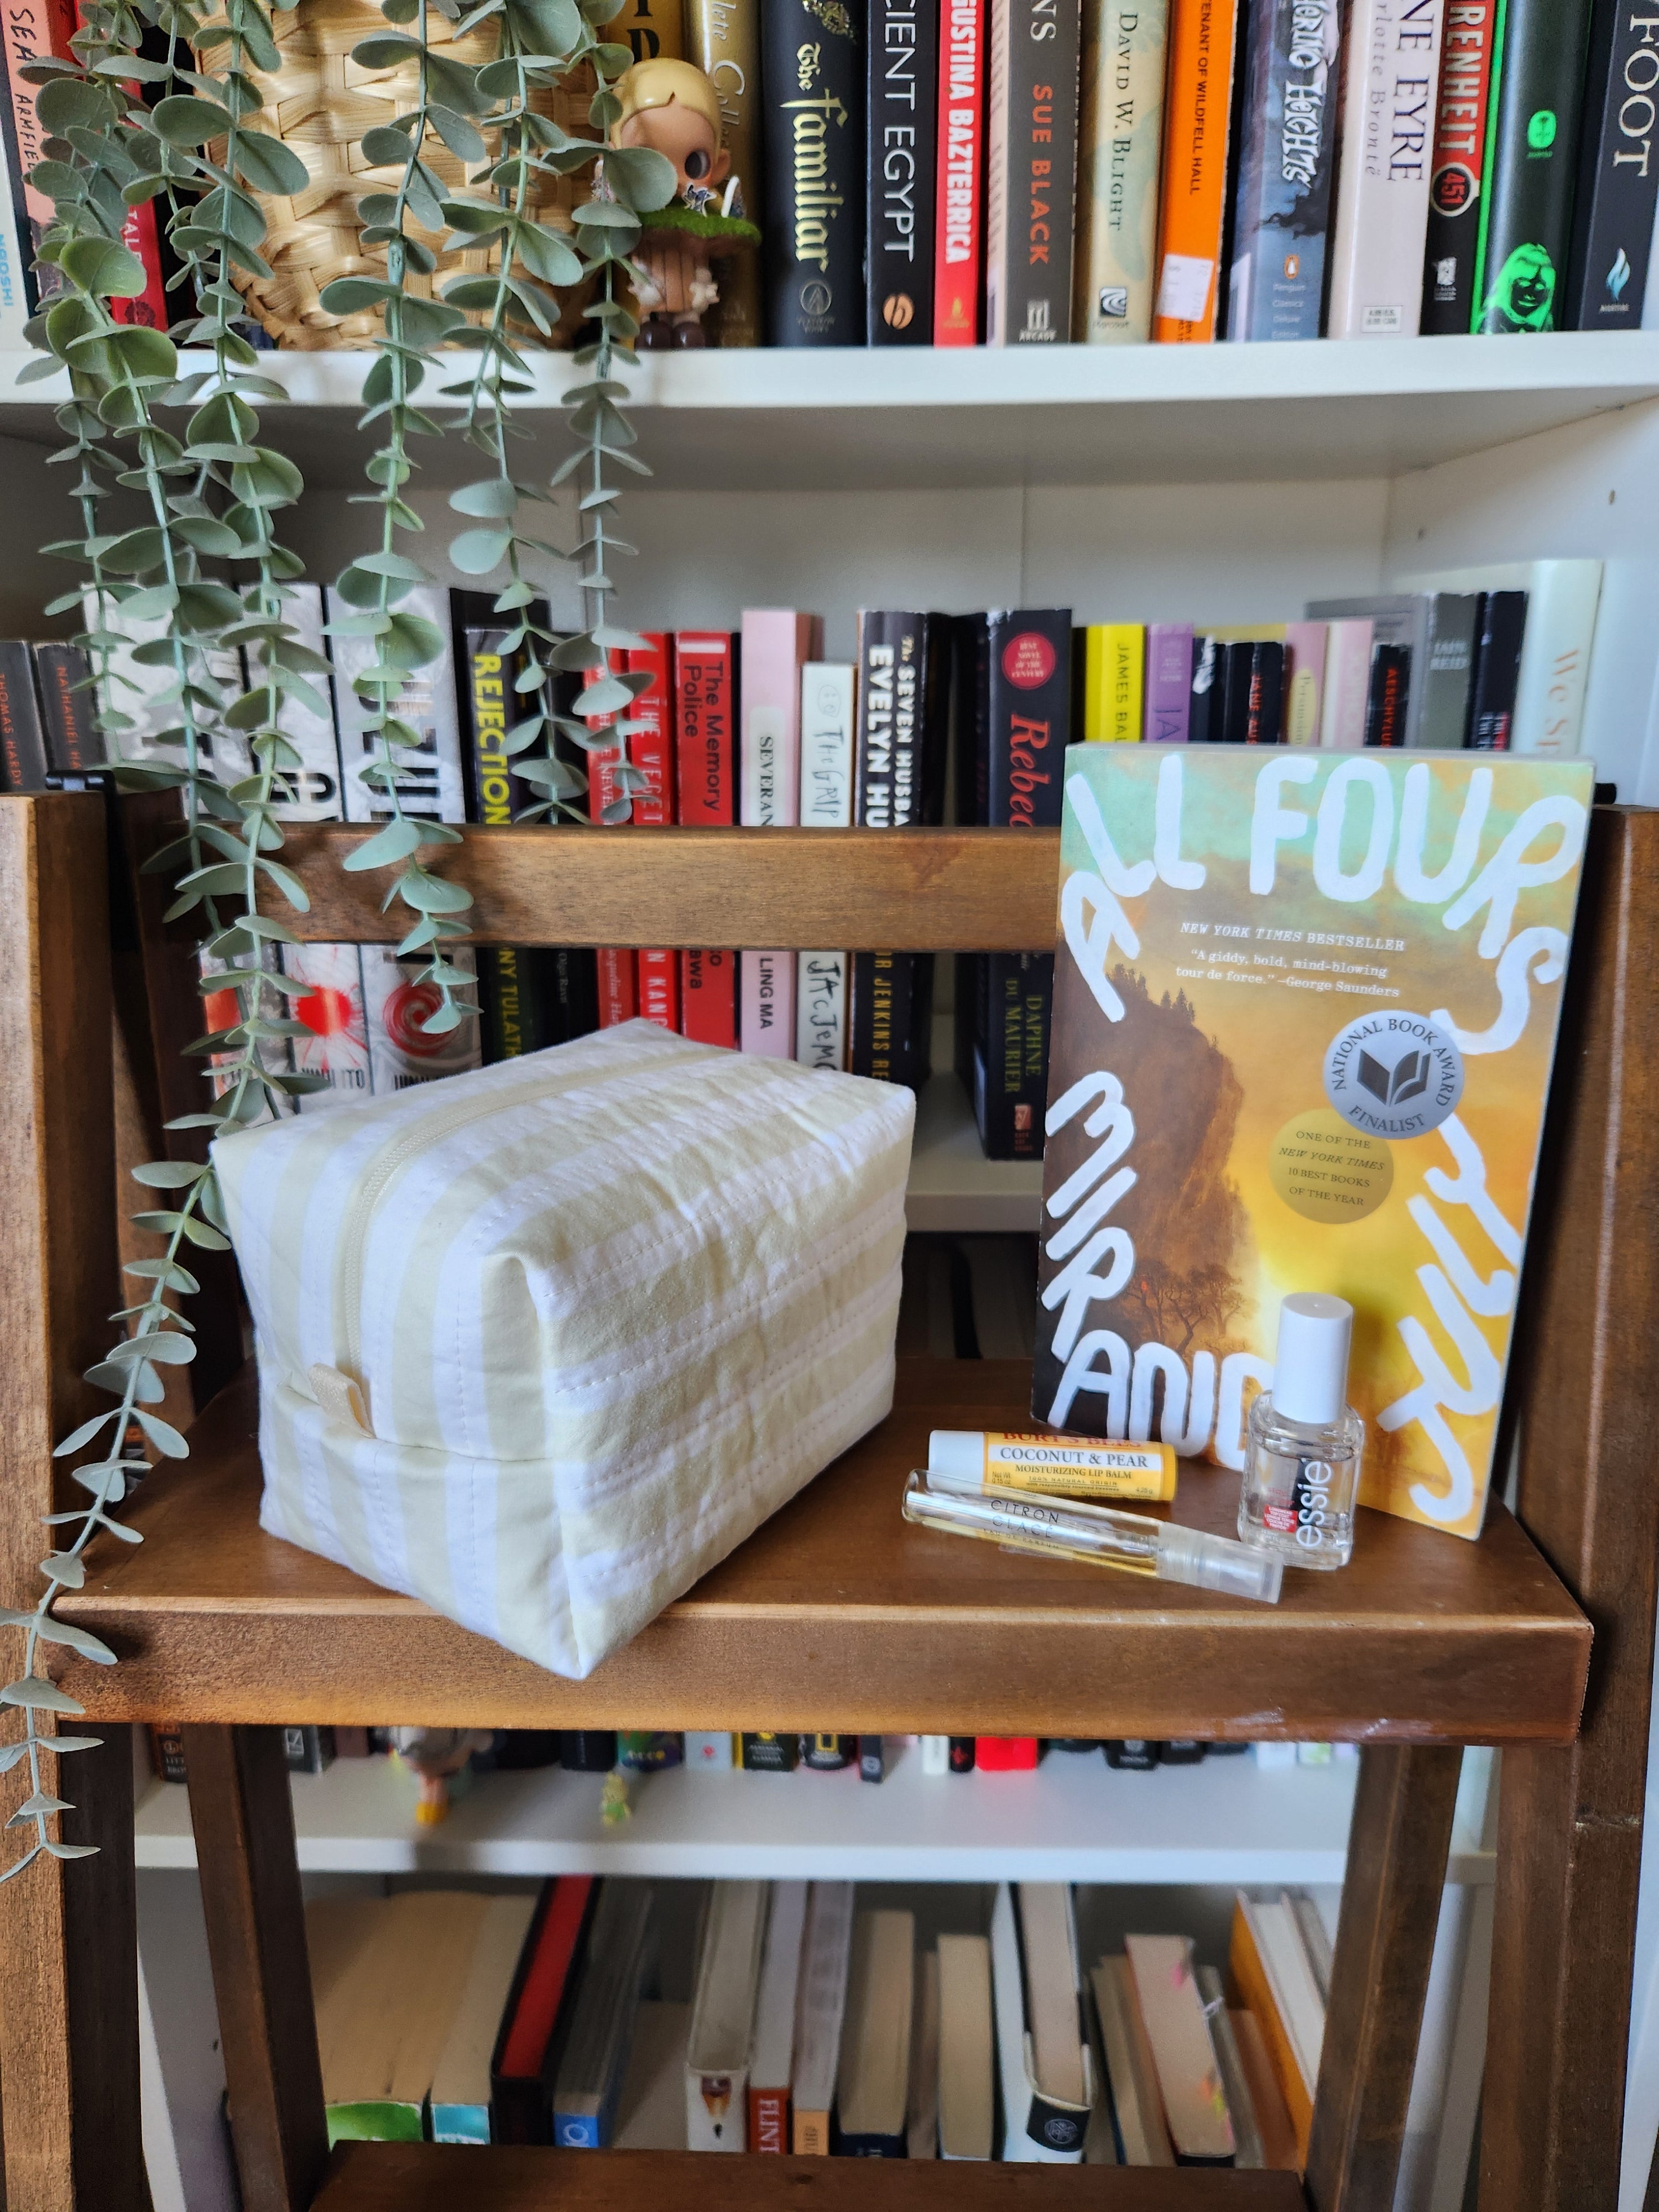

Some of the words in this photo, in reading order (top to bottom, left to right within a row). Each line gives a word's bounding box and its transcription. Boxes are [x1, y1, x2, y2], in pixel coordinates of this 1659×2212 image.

[10, 8, 37, 61] SEA
[797, 42, 820, 91] The
[1198, 58, 1208, 76] OF
[1438, 6, 1486, 155] RENHEIT
[1032, 84, 1053, 143] SUE
[1114, 100, 1134, 130] W.
[1191, 82, 1207, 154] WILDFELL
[1612, 14, 1659, 177] FOOT
[1365, 90, 1386, 179] Brontë
[1386, 74, 1430, 181] EYRE
[883, 127, 915, 263] EGYPT
[946, 109, 973, 264] BAZTERRICA
[1190, 158, 1202, 195] HALL
[1441, 173, 1465, 205] 451
[1029, 160, 1051, 265] BLACK
[706, 662, 723, 707] The
[1115, 643, 1129, 703] JAMES
[0, 673, 14, 734] THOMAS
[684, 665, 702, 738] Police
[867, 645, 894, 774] EVELYN
[896, 665, 916, 743] SEVEN
[4, 741, 23, 786] HARDY
[474, 654, 511, 825] REJECTION
[702, 714, 722, 812] Memory
[865, 782, 891, 827] HU
[894, 749, 914, 826] HUSBA
[1061, 754, 1206, 1023] ALL
[1250, 756, 1588, 1055] FOURS
[647, 952, 666, 963] N
[874, 952, 893, 968] R
[1180, 922, 1208, 935] NEW
[1213, 925, 1250, 938] YORK
[1256, 928, 1301, 942] TIMES
[1306, 933, 1405, 952] BESTSELLER
[499, 947, 517, 979] NY
[759, 957, 774, 998] LING
[1176, 967, 1203, 978] tour
[1207, 969, 1222, 980] de
[1335, 982, 1400, 997] Saunders
[1208, 952, 1248, 965] giddy,
[1254, 955, 1287, 969] bold,
[1293, 959, 1387, 979] mind-blowing
[873, 978, 892, 1050] JENKINS
[1005, 978, 1019, 1002] DU
[760, 1003, 774, 1030] MA
[1025, 995, 1043, 1077] DAPHNE
[1005, 1006, 1022, 1093] MAURIER
[1332, 1020, 1383, 1091] NATIONAL
[1387, 1018, 1439, 1046] BOOK
[1433, 1047, 1456, 1107] AWARD
[1296, 1130, 1321, 1142] ONE
[1326, 1135, 1342, 1144] OF
[1345, 1138, 1371, 1149] THE
[1348, 1105, 1425, 1133] FINALIST
[1279, 1147, 1307, 1157] NEW
[1311, 1152, 1343, 1165] YORK
[1347, 1157, 1385, 1171] TIMES
[1288, 1167, 1298, 1177] 10
[1301, 1170, 1328, 1181] BEST
[1331, 1174, 1370, 1188] BOOKS
[1289, 1187, 1306, 1196] OF
[1307, 1189, 1331, 1201] THE
[1336, 1193, 1364, 1207] YEAR
[1376, 1113, 1522, 1524] JULY
[1000, 1447, 1084, 1463] COCONUT
[1089, 1453, 1102, 1464] &
[1106, 1454, 1149, 1467] PEAR
[1015, 1464, 1086, 1476] MOISTURIZING
[1106, 1470, 1131, 1479] BALM
[991, 1500, 1059, 1523] CITRON
[1296, 1460, 1332, 1547] essie
